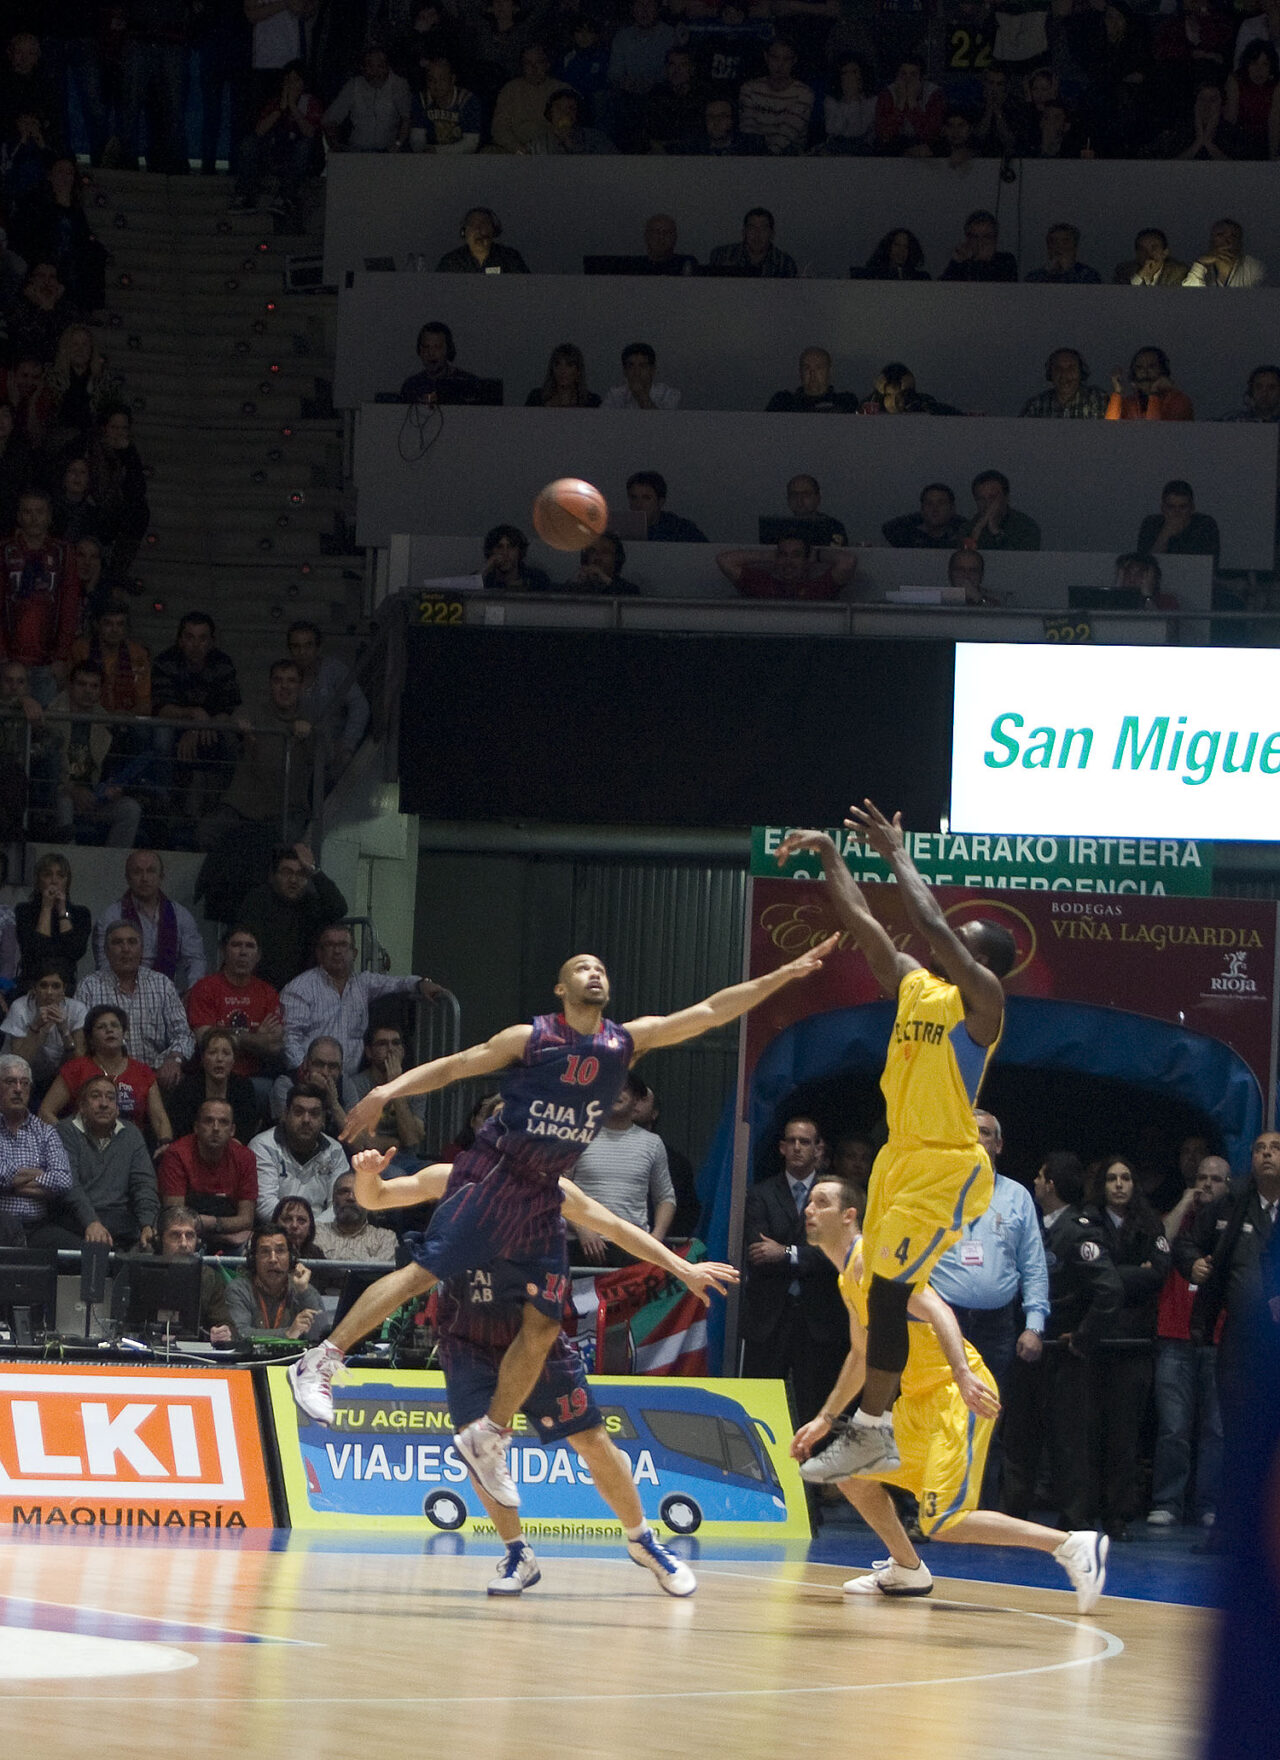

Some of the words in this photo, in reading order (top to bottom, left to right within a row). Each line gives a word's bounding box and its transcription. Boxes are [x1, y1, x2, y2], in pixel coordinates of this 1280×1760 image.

[419, 601, 464, 625] 222
[984, 712, 1094, 769] San
[1112, 716, 1280, 785] Migue
[1070, 837, 1202, 867] IRTEERA
[1051, 901, 1123, 916] BODEGAS
[1051, 916, 1113, 942] VIÑA
[1121, 922, 1263, 951] LAGUARDIA
[560, 1054, 599, 1086] 10
[895, 1237, 910, 1266] 4
[333, 1408, 366, 1427] TU
[371, 1410, 455, 1429] AGENC
[558, 1387, 588, 1422] 19
[326, 1443, 468, 1482] VIAJES
